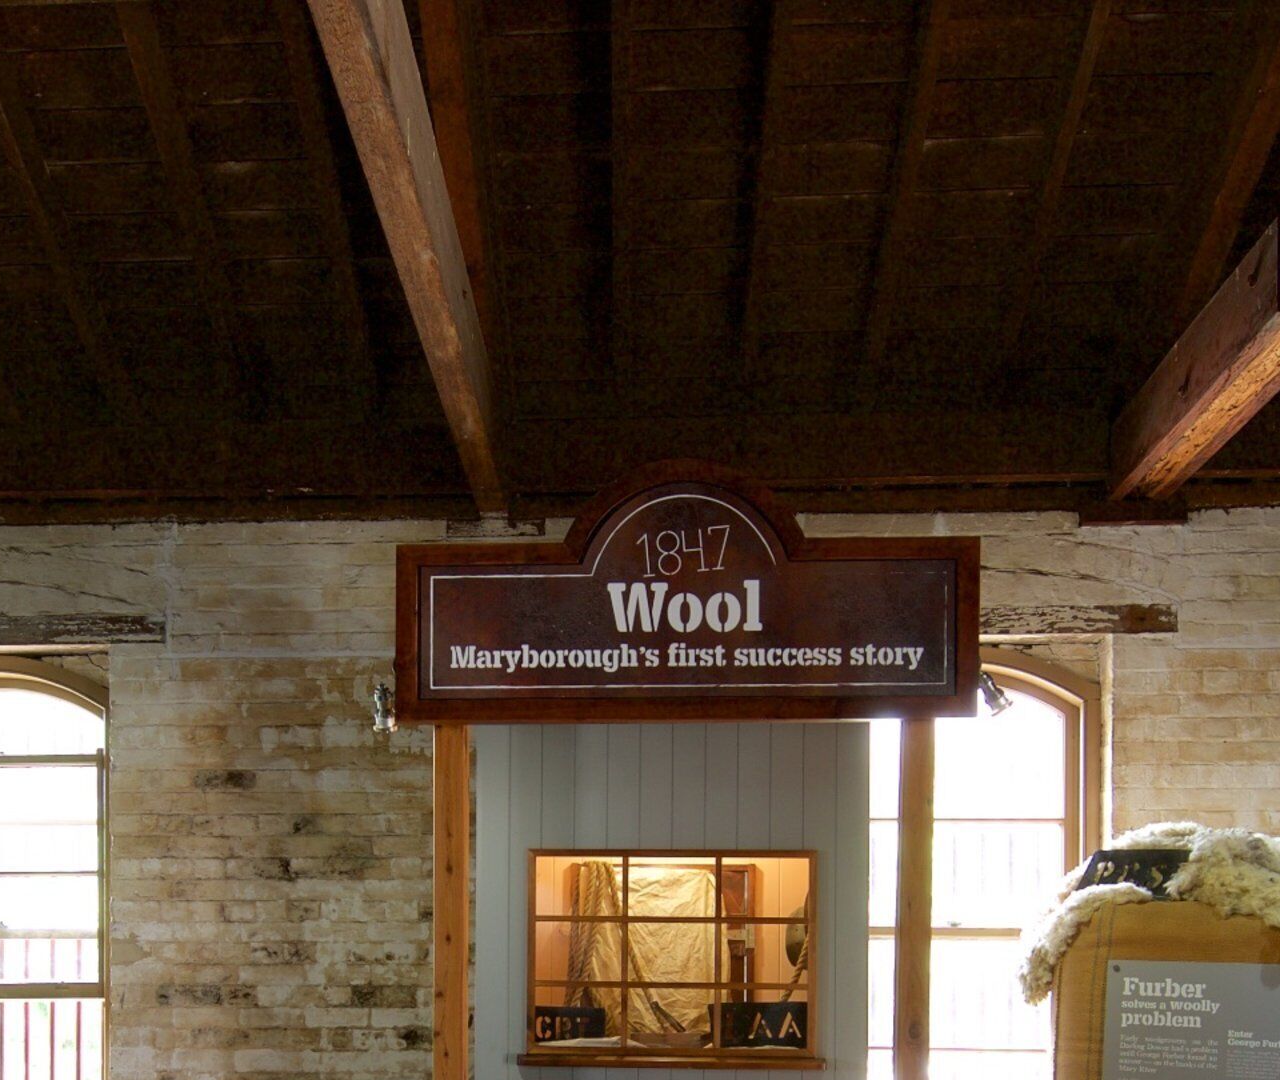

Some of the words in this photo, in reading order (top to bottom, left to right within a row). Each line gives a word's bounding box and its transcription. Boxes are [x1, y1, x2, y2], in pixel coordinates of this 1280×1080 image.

[636, 523, 732, 578] 1847
[607, 579, 763, 633] Wool
[450, 643, 660, 674] Maryborough’s
[666, 642, 727, 668] first
[734, 644, 842, 668] success
[850, 644, 924, 671] story
[1122, 976, 1207, 998] Furber
[1121, 999, 1157, 1011] solves
[1159, 1001, 1167, 1011] a
[1169, 999, 1221, 1014] woolly
[1120, 1011, 1202, 1029] problem
[1227, 1029, 1254, 1039] Enter
[1227, 1038, 1261, 1049] George
